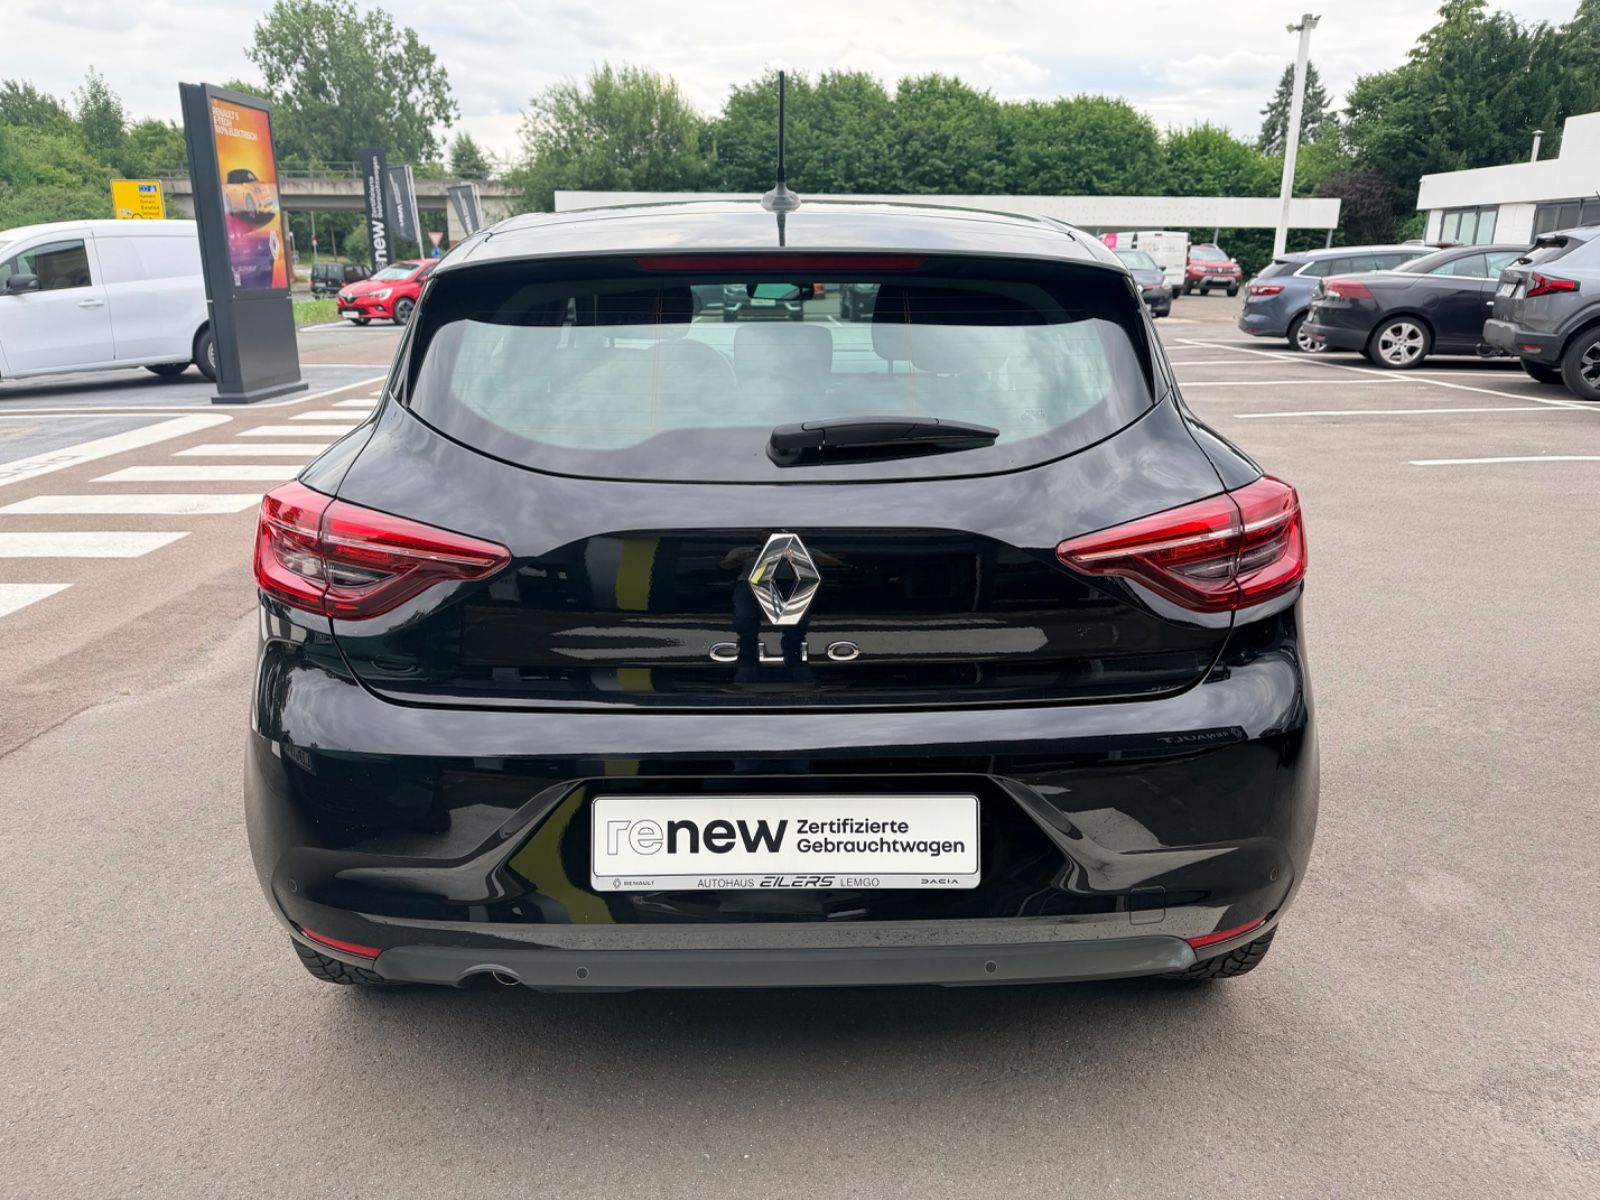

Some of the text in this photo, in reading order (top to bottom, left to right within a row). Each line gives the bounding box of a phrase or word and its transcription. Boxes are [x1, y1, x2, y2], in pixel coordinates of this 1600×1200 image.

[709, 641, 860, 663] CLIO
[796, 818, 909, 835] Zertifizierte
[606, 818, 788, 857] renew
[796, 837, 965, 857] Gebrauchtwagen
[623, 879, 655, 887] RENAULT
[697, 875, 880, 889] AUTOHAUS EILERS LEMGO
